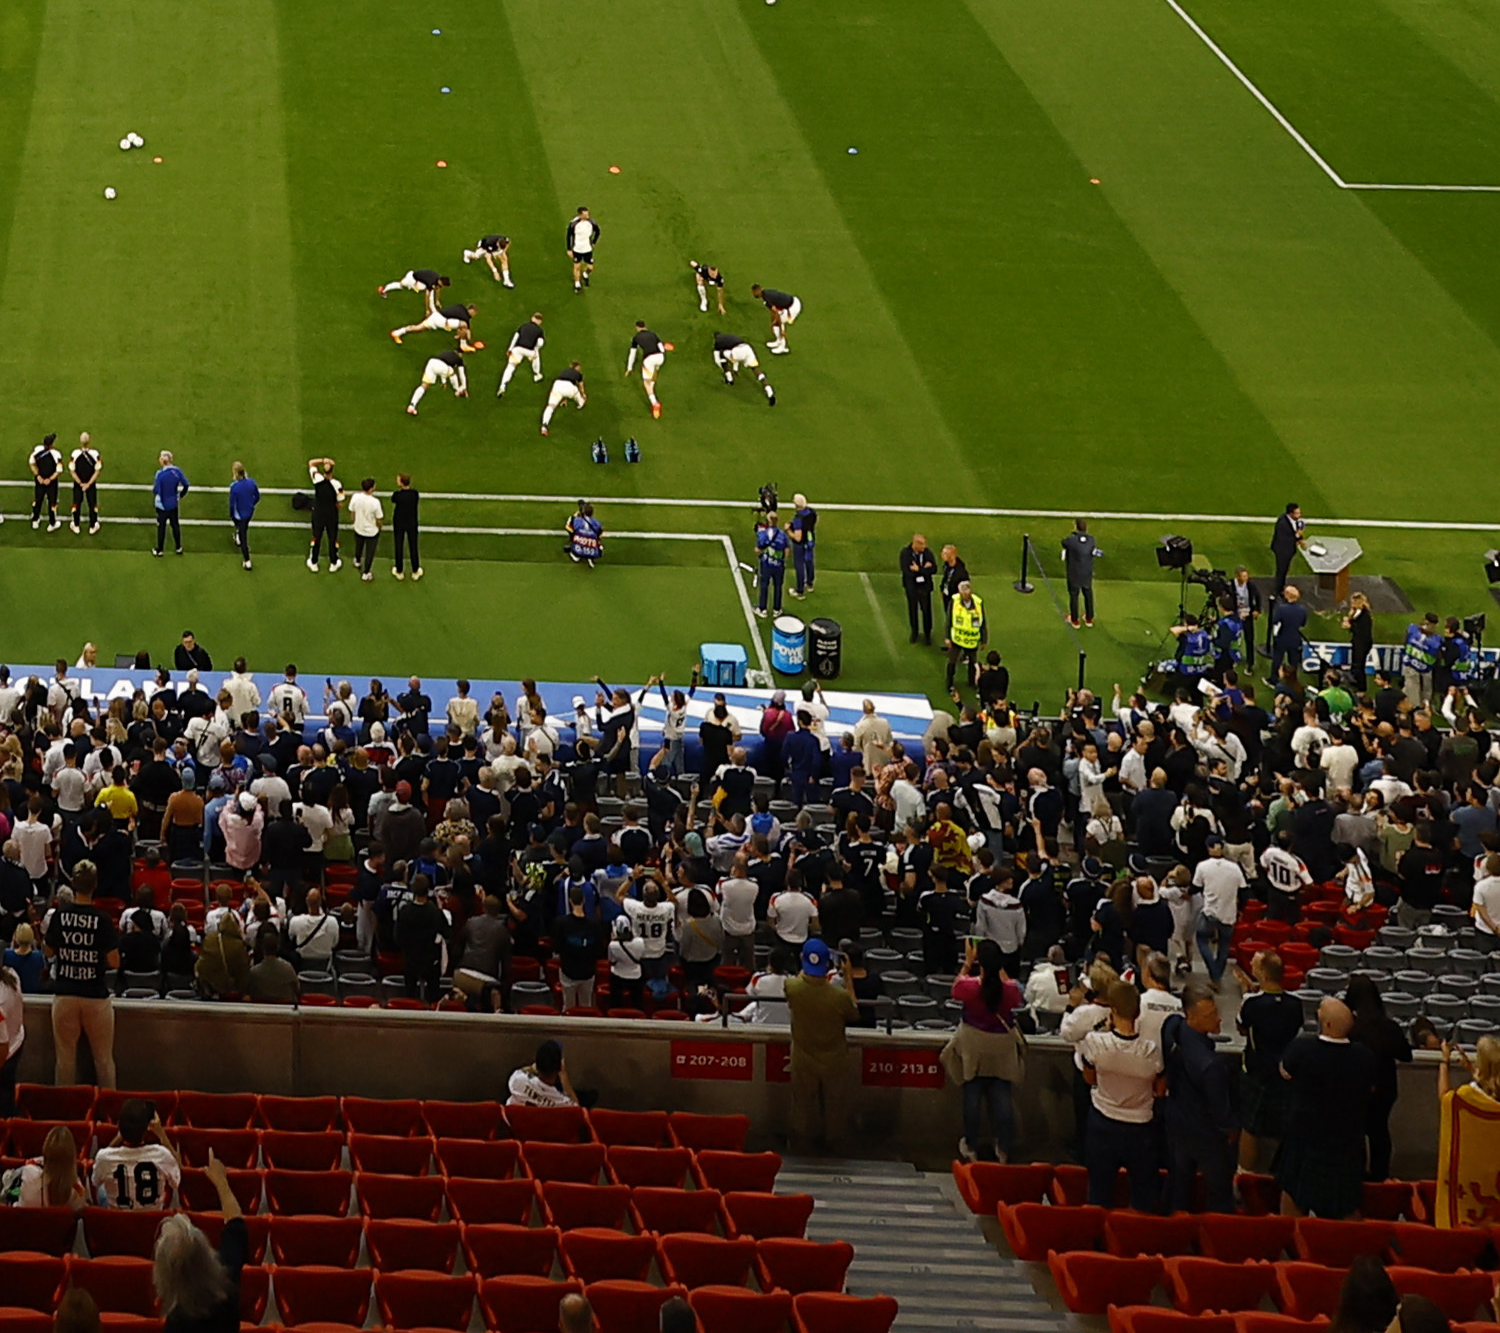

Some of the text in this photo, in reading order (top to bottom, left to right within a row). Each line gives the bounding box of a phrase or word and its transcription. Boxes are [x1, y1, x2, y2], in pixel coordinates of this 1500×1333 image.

[60, 913, 99, 930] WISH
[61, 931, 95, 947] YOU
[636, 922, 665, 940] 18
[60, 948, 99, 965] WERE
[60, 966, 98, 982] HERE
[111, 1162, 160, 1207] 18
